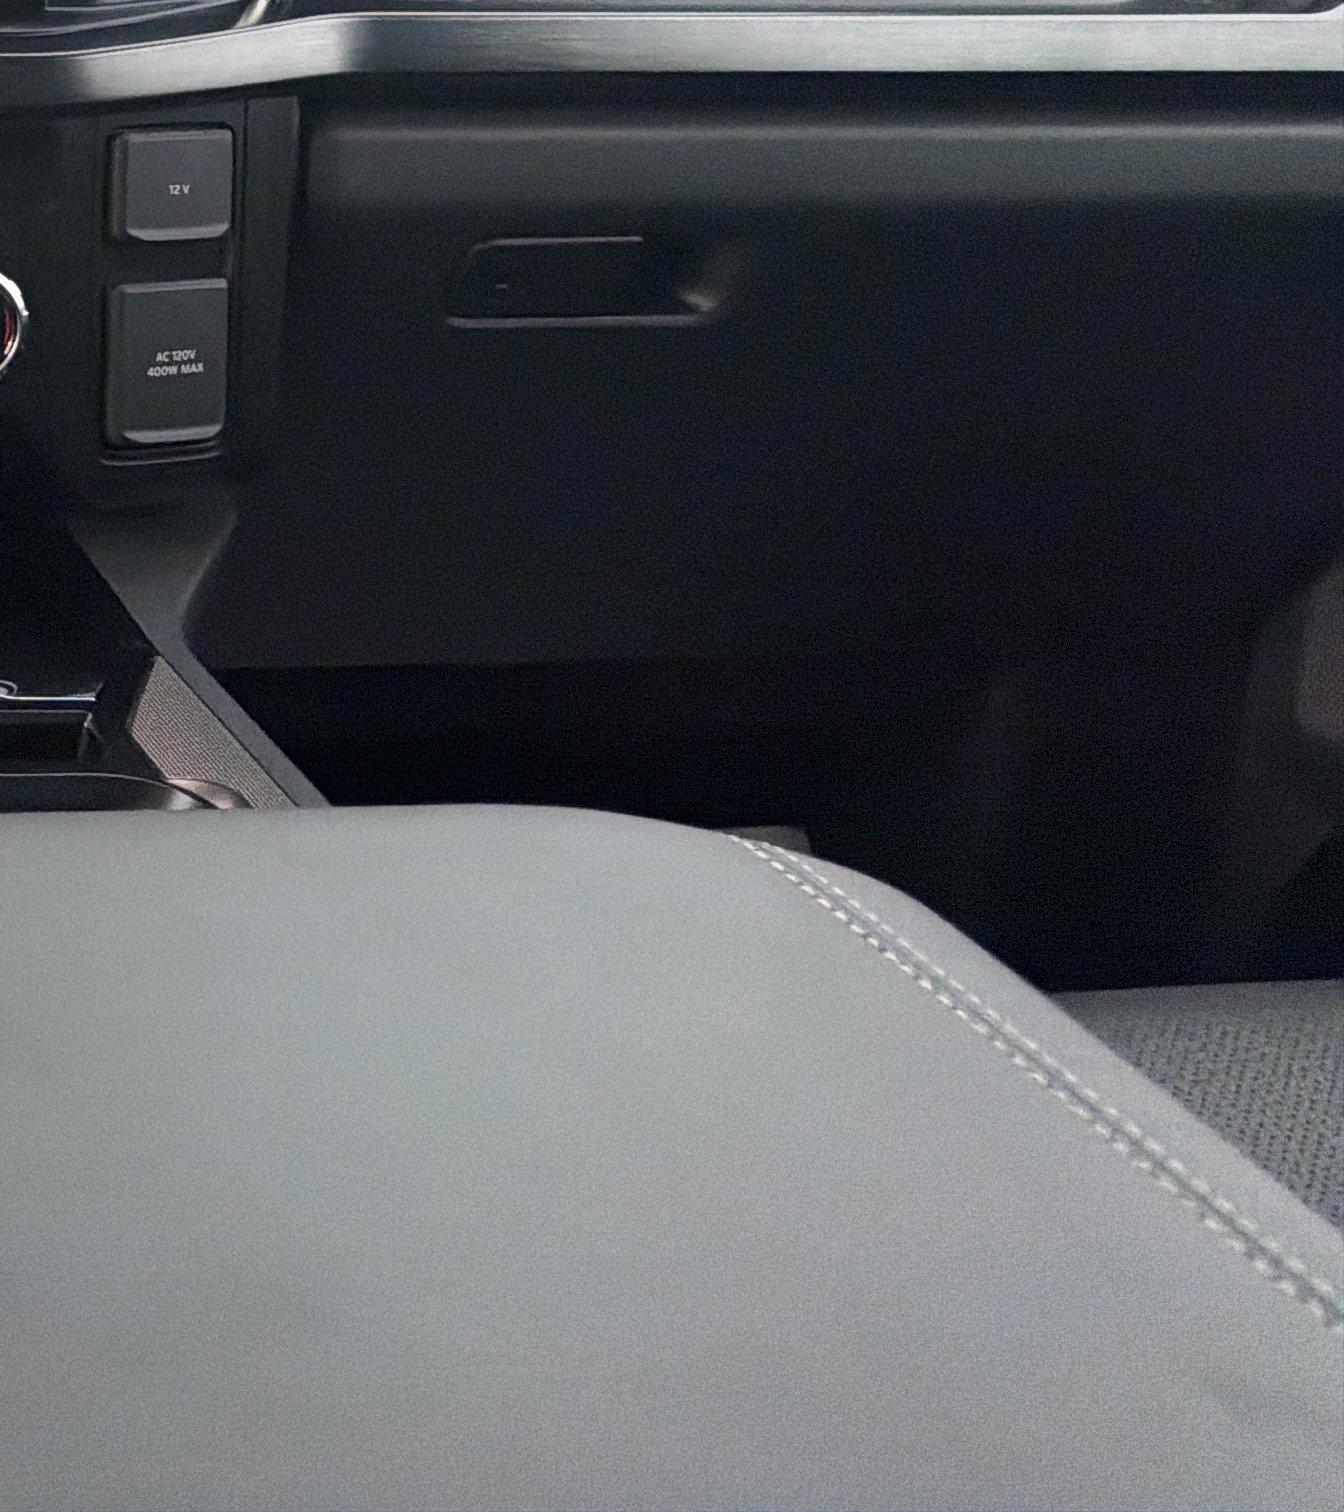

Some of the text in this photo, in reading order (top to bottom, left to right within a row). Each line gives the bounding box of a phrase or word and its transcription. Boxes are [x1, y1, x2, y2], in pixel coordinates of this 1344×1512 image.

[155, 349, 197, 363] AC 120V
[146, 362, 204, 377] 400W MAX
